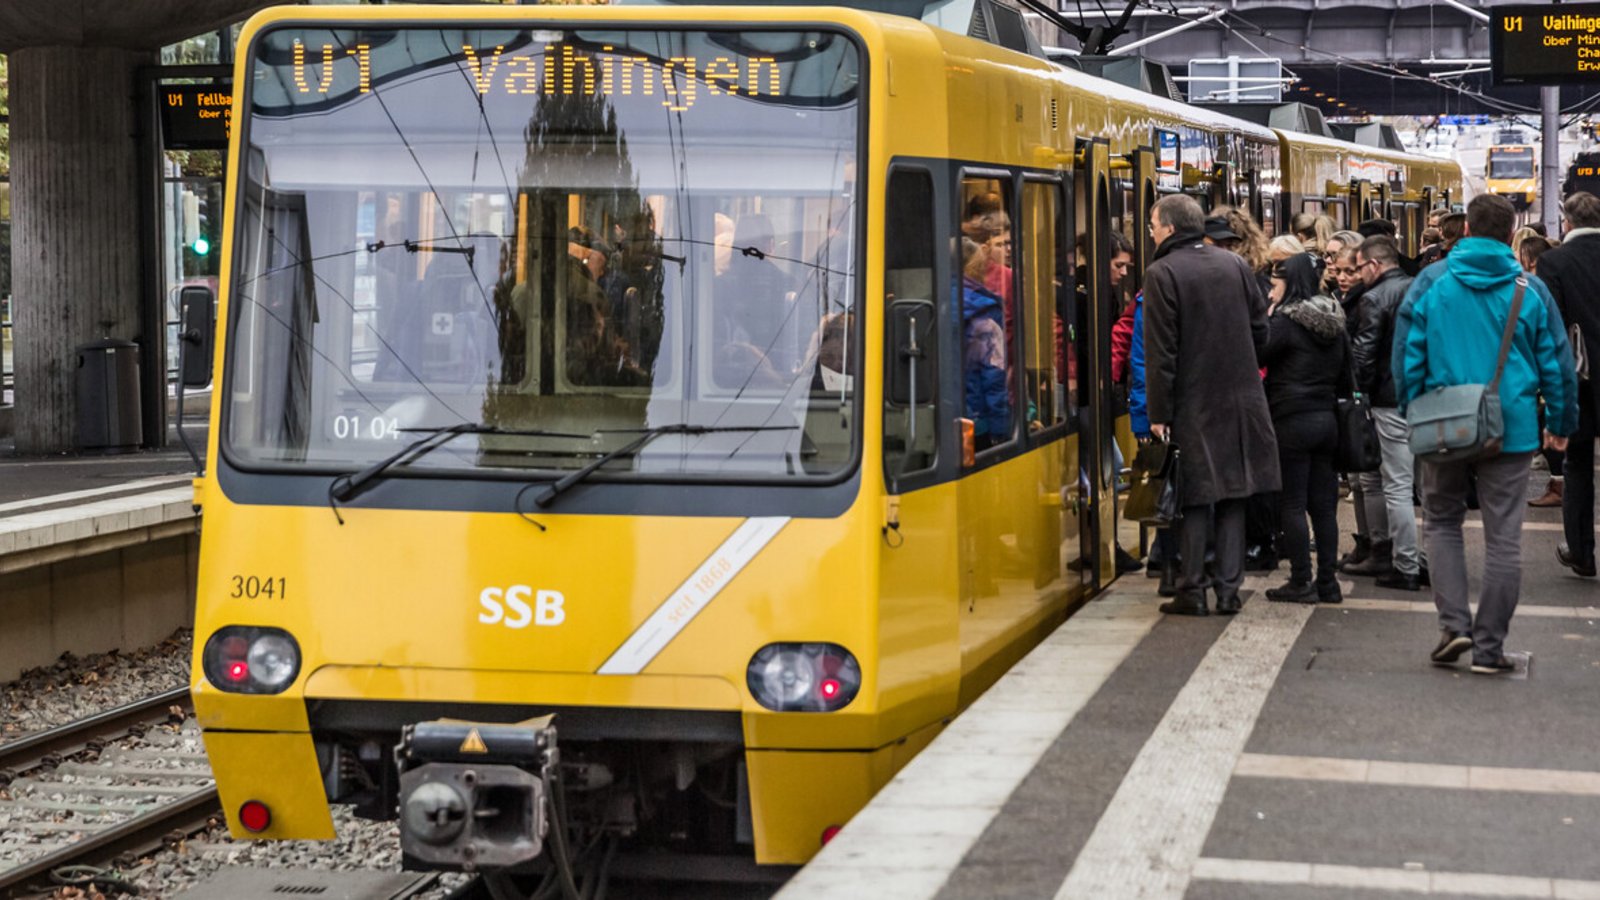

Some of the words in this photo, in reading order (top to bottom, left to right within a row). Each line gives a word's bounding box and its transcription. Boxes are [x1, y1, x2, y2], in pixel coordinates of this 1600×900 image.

[1503, 16, 1523, 32] U1
[1577, 34, 1600, 45] Min
[1577, 47, 1600, 58] Cha
[294, 45, 370, 93] U1
[462, 45, 780, 111] Vaihingen
[168, 93, 183, 106] U1
[334, 415, 359, 439] 01
[370, 416, 401, 440] 04
[231, 574, 286, 600] 3041
[667, 594, 695, 624] seit
[694, 557, 732, 595] 1868
[479, 584, 566, 629] SSB
